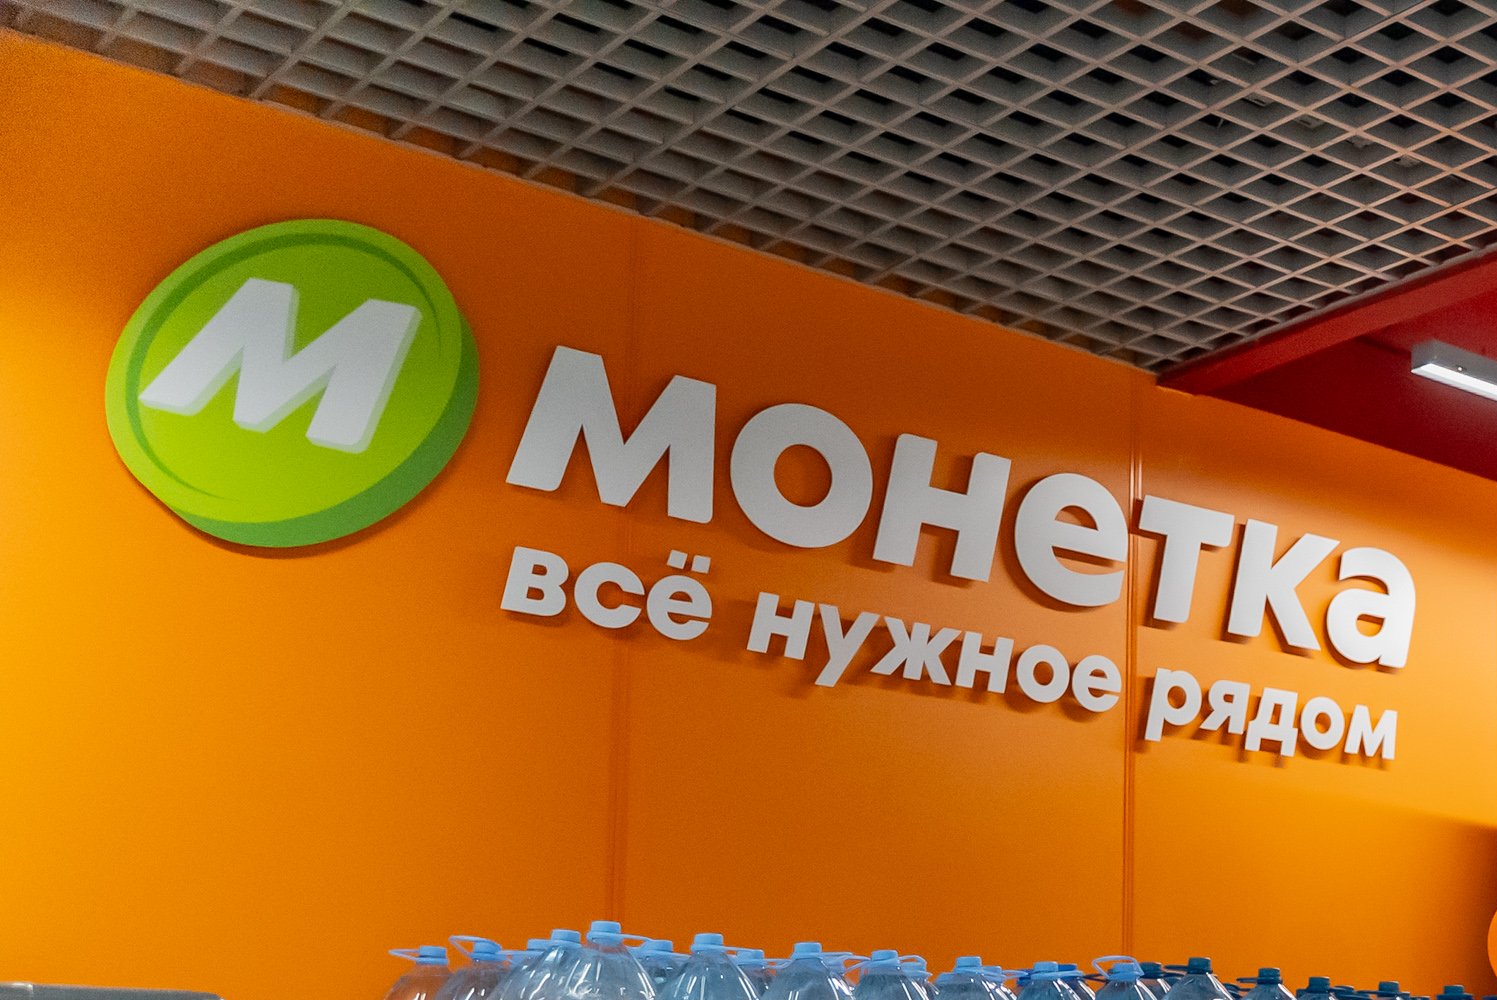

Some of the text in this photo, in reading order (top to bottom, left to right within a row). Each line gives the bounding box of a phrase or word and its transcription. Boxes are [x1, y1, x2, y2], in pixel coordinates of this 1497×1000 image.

[138, 277, 422, 455] М
[506, 345, 1416, 668] Монетка
[500, 549, 1398, 760] всё нужное рядом
